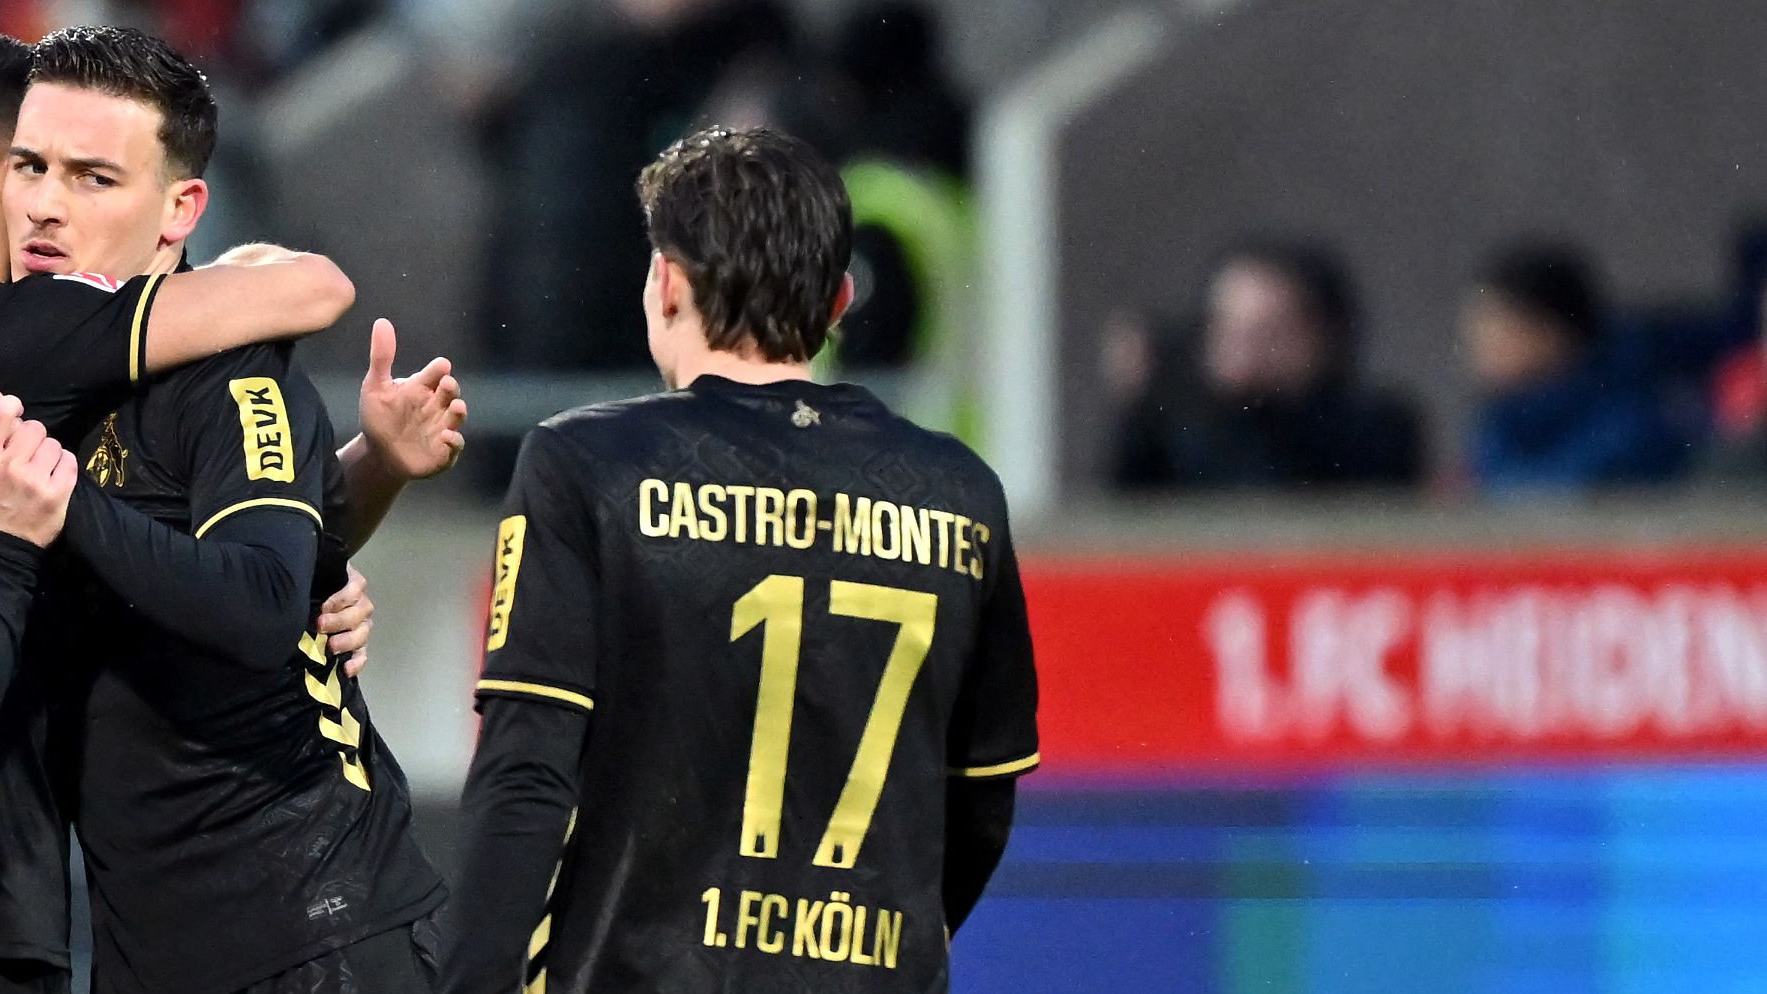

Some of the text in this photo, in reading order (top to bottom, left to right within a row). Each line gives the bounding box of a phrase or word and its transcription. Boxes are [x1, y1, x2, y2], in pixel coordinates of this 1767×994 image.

[245, 387, 284, 471] DEVK
[639, 478, 990, 580] CASTRO-MONTES
[730, 574, 938, 869] 17
[701, 886, 903, 968] 1. FC KÖLN
